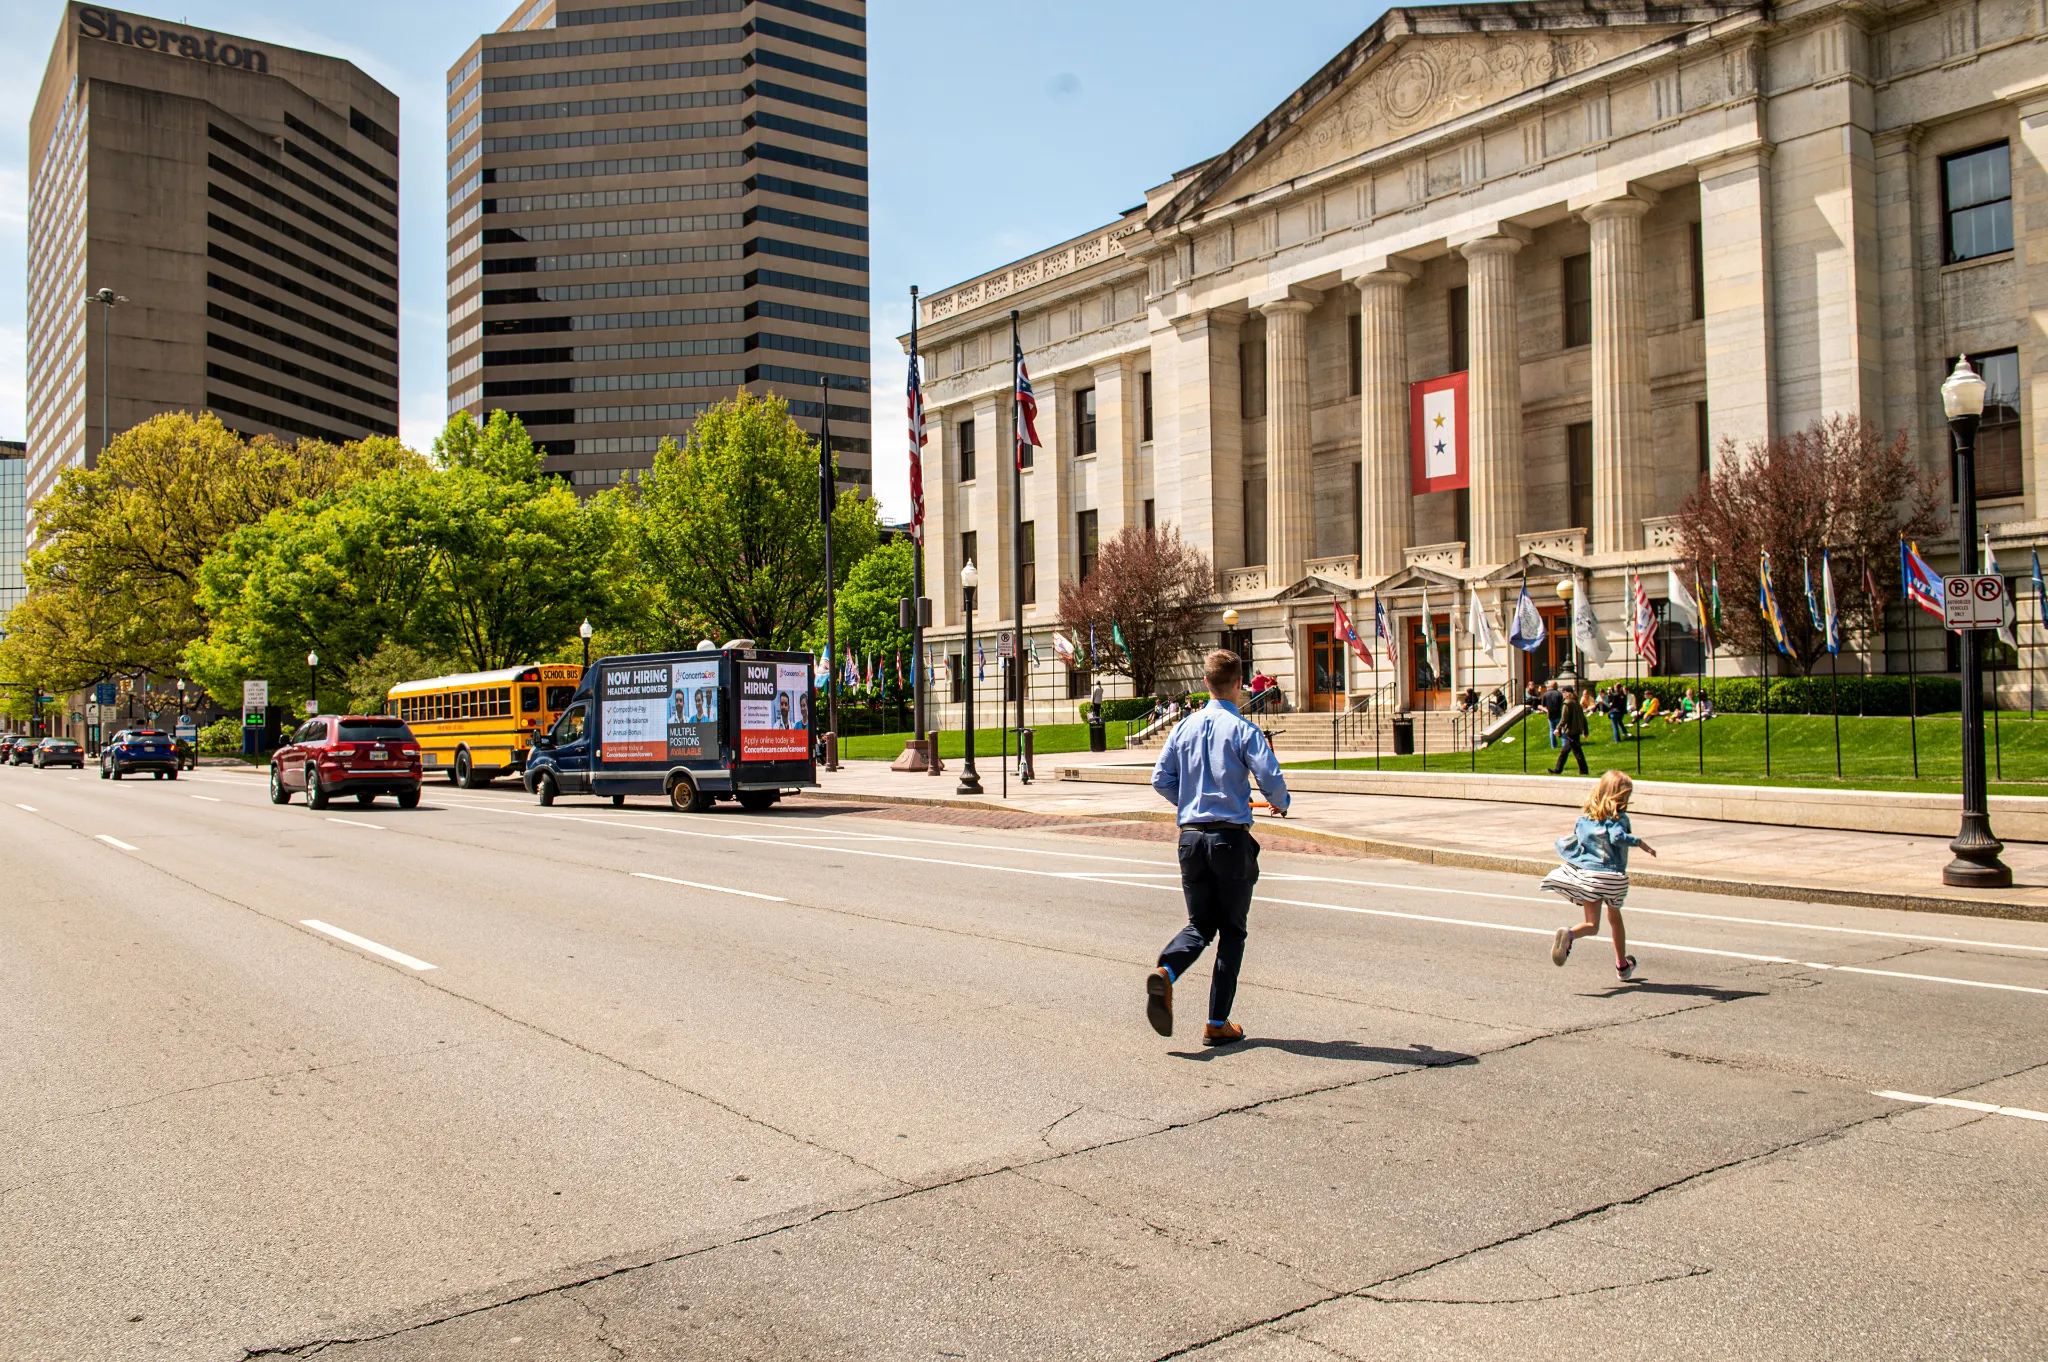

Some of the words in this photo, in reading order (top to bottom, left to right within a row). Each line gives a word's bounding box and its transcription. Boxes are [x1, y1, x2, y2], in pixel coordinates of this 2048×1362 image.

[79, 6, 267, 73] Sheraton
[544, 670, 565, 679] SCHOOL
[567, 670, 578, 678] BUS
[682, 671, 715, 680] ConcertoCare
[748, 666, 769, 679] NOW
[608, 671, 630, 686] NOW
[634, 669, 667, 684] HIRING
[608, 686, 640, 696] HEALTHCARE
[642, 685, 667, 694] WORKERS
[744, 682, 773, 695] HIRING
[670, 727, 696, 736] MULTIPLE
[670, 737, 699, 746] POSITIONS
[744, 737, 758, 745] Apply
[775, 737, 788, 745] today
[670, 748, 702, 756] AVAILABLE
